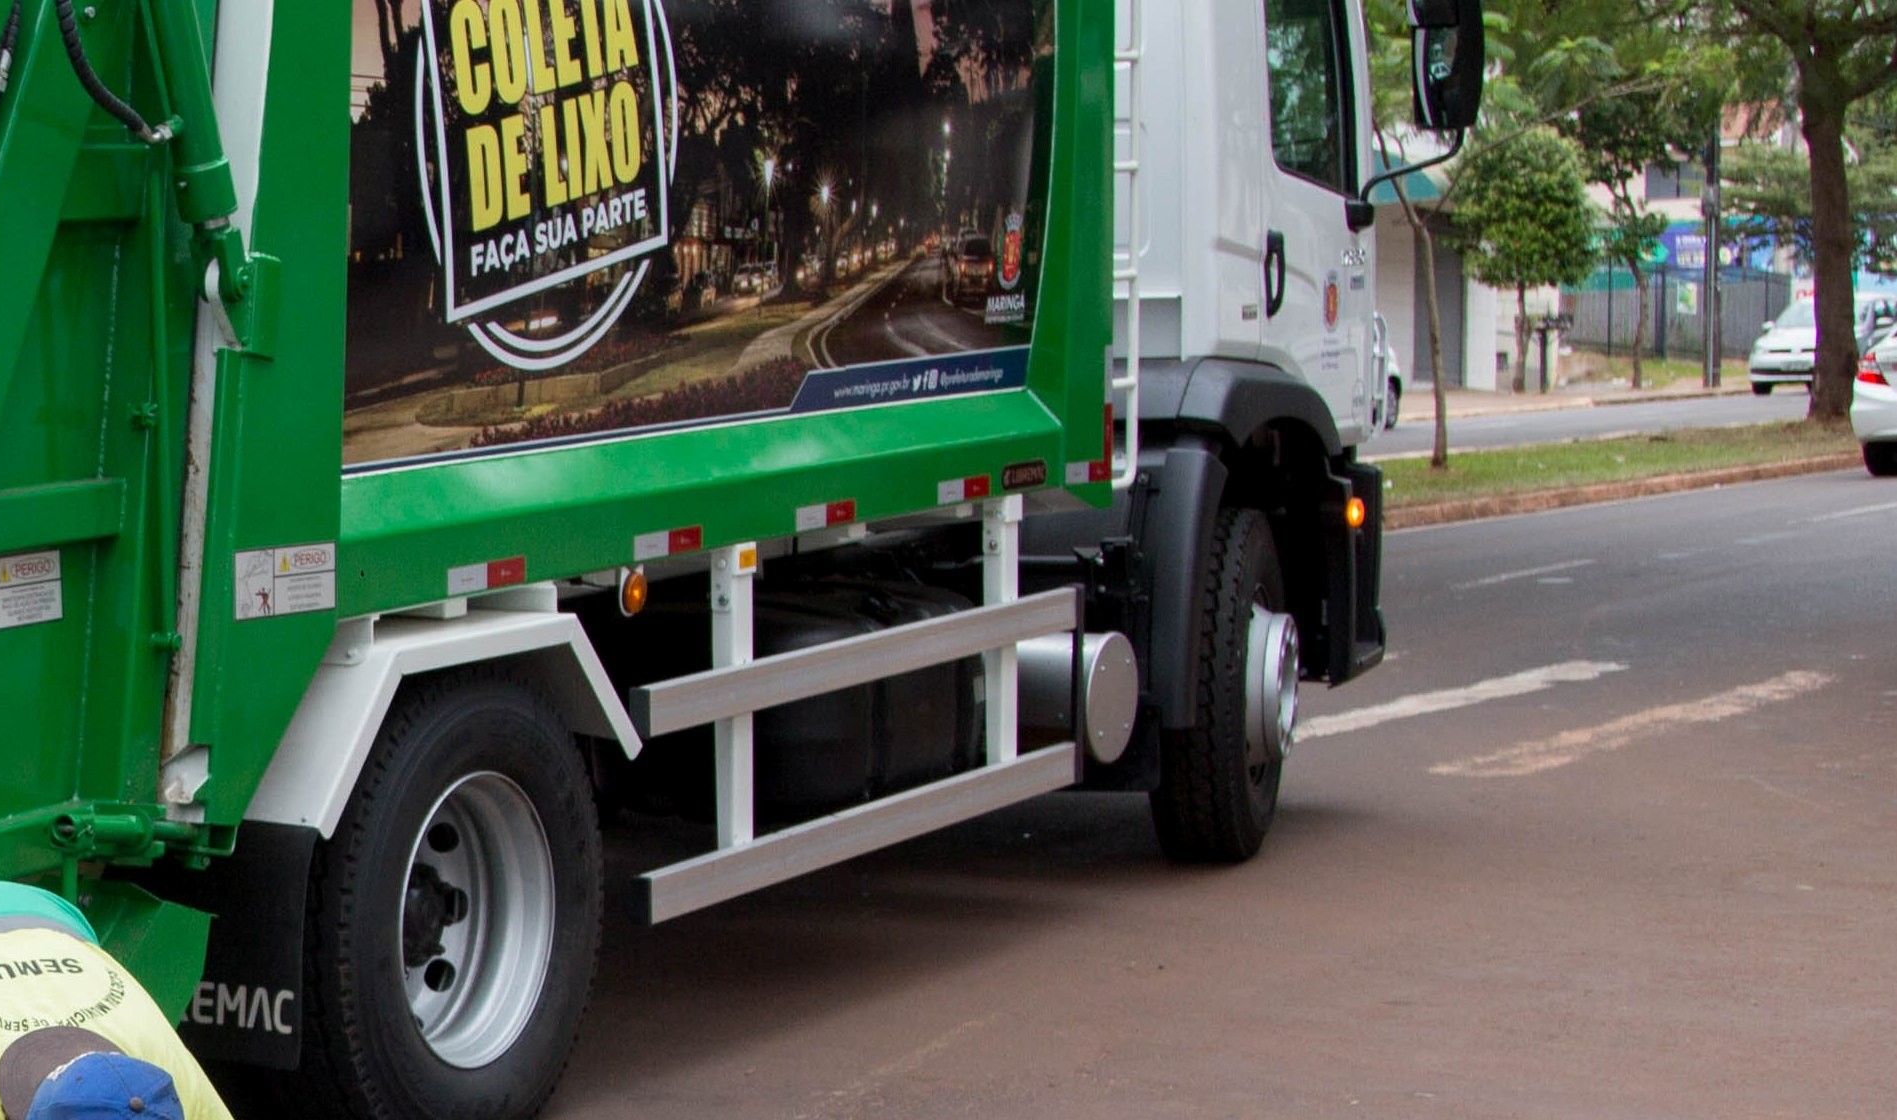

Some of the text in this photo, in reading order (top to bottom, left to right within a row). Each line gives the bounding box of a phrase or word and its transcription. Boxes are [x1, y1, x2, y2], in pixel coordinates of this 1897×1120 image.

[466, 81, 641, 233] DE LIXO
[470, 188, 647, 277] FAÇA SUA PARTE
[14, 560, 50, 576] PERIGO
[181, 980, 295, 1034] EMAC
